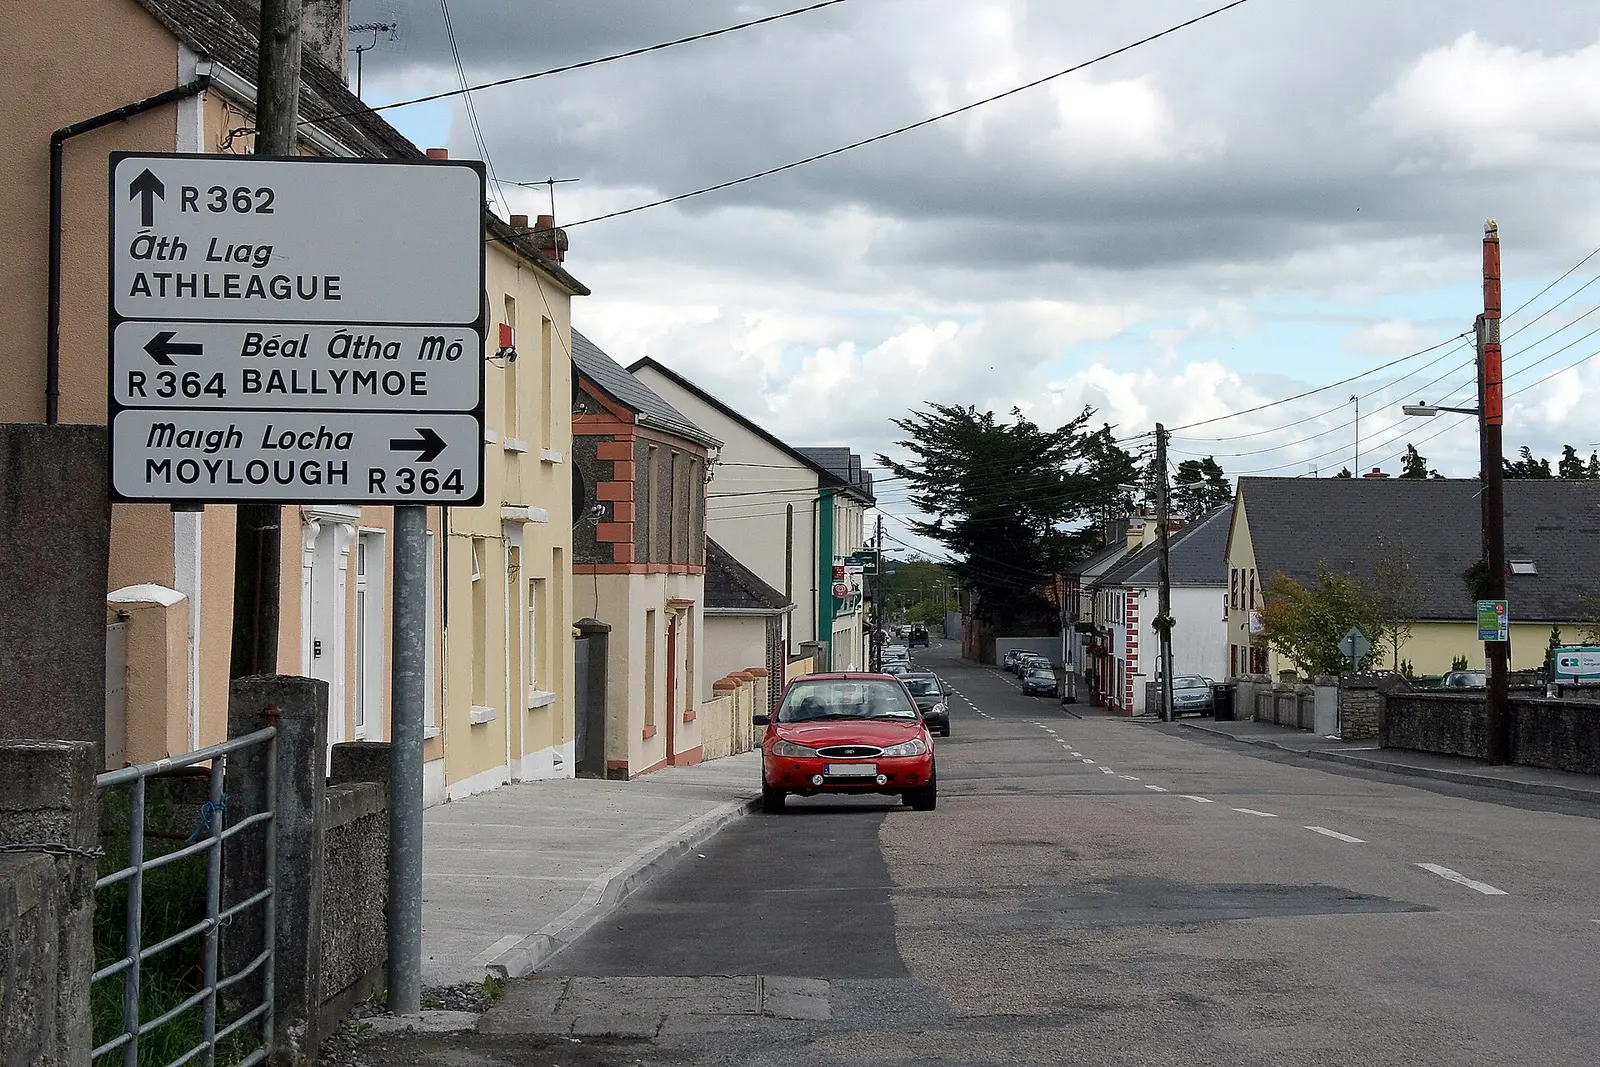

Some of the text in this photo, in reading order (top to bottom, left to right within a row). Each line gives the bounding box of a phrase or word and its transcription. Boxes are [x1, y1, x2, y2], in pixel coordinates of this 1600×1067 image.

[129, 229, 188, 261] Áth
[128, 272, 342, 301] ATHLEAGUE
[240, 331, 310, 359] Béal
[327, 328, 402, 360] Átha
[241, 369, 428, 395] BALLYMOE
[261, 424, 354, 451] Locha
[145, 458, 349, 486] MOYLOUGH
